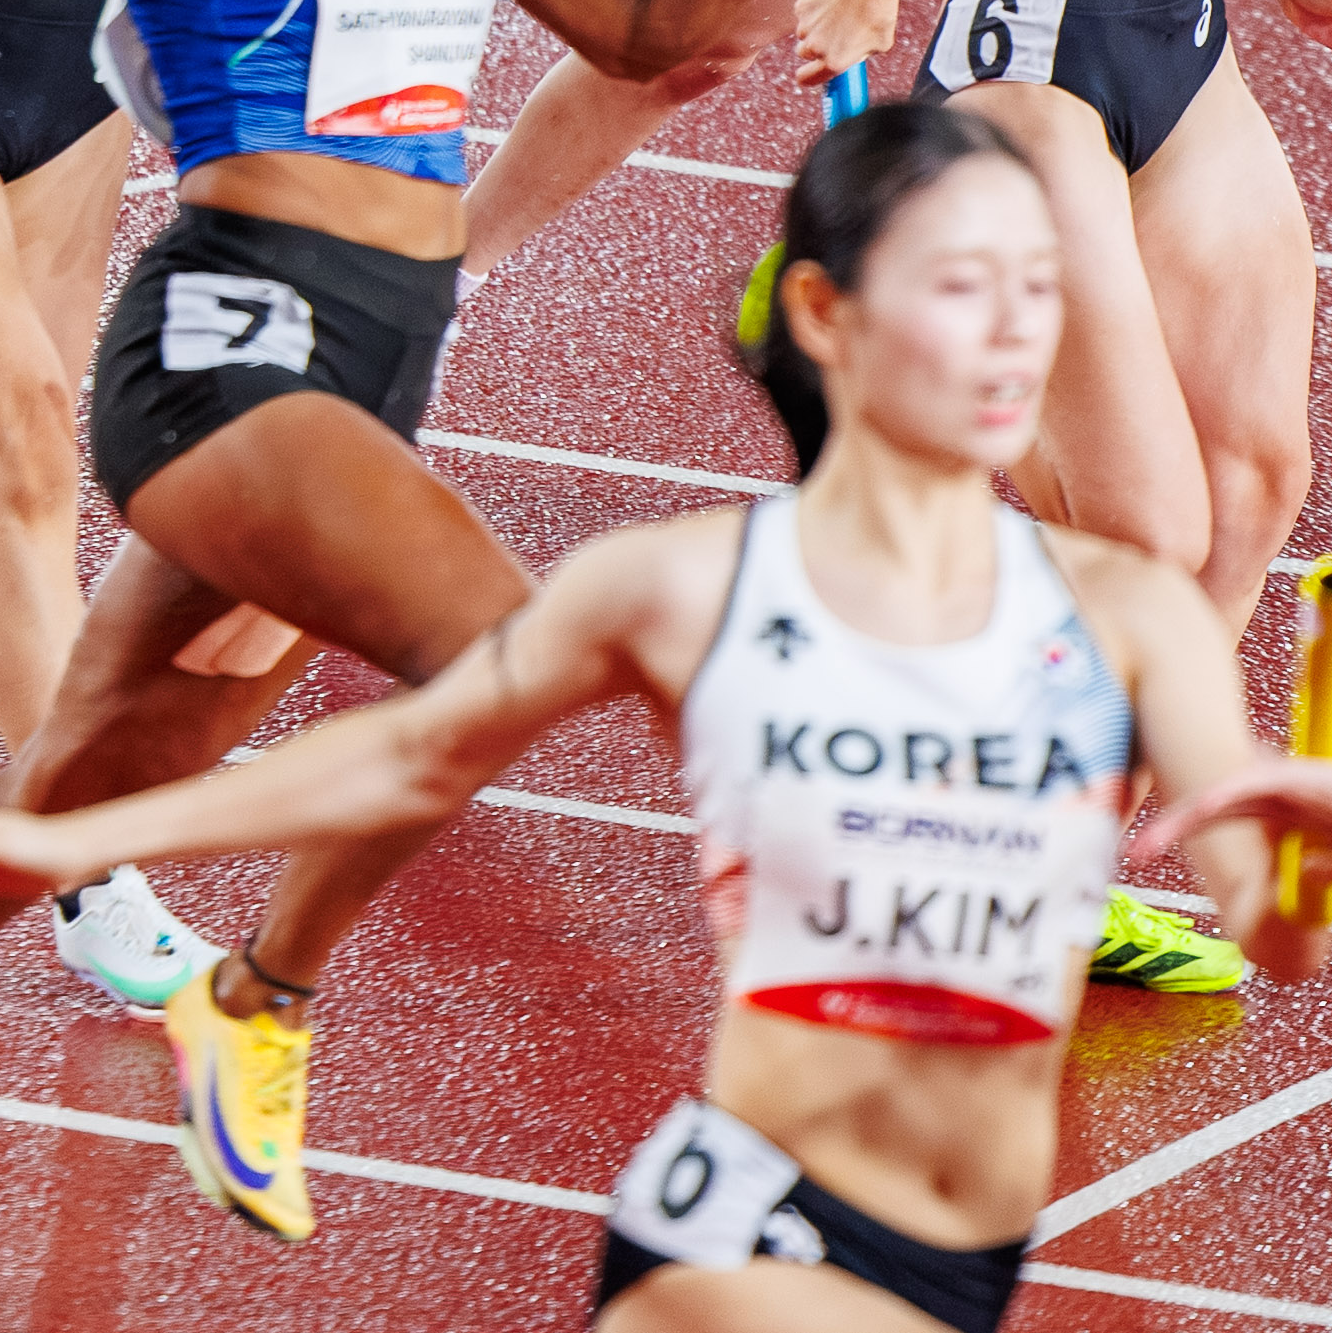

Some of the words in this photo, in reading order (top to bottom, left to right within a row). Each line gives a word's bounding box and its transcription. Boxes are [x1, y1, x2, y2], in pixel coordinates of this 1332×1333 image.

[218, 296, 274, 349] 7
[761, 721, 1089, 795] KOREA
[803, 878, 1043, 958] J.KIM
